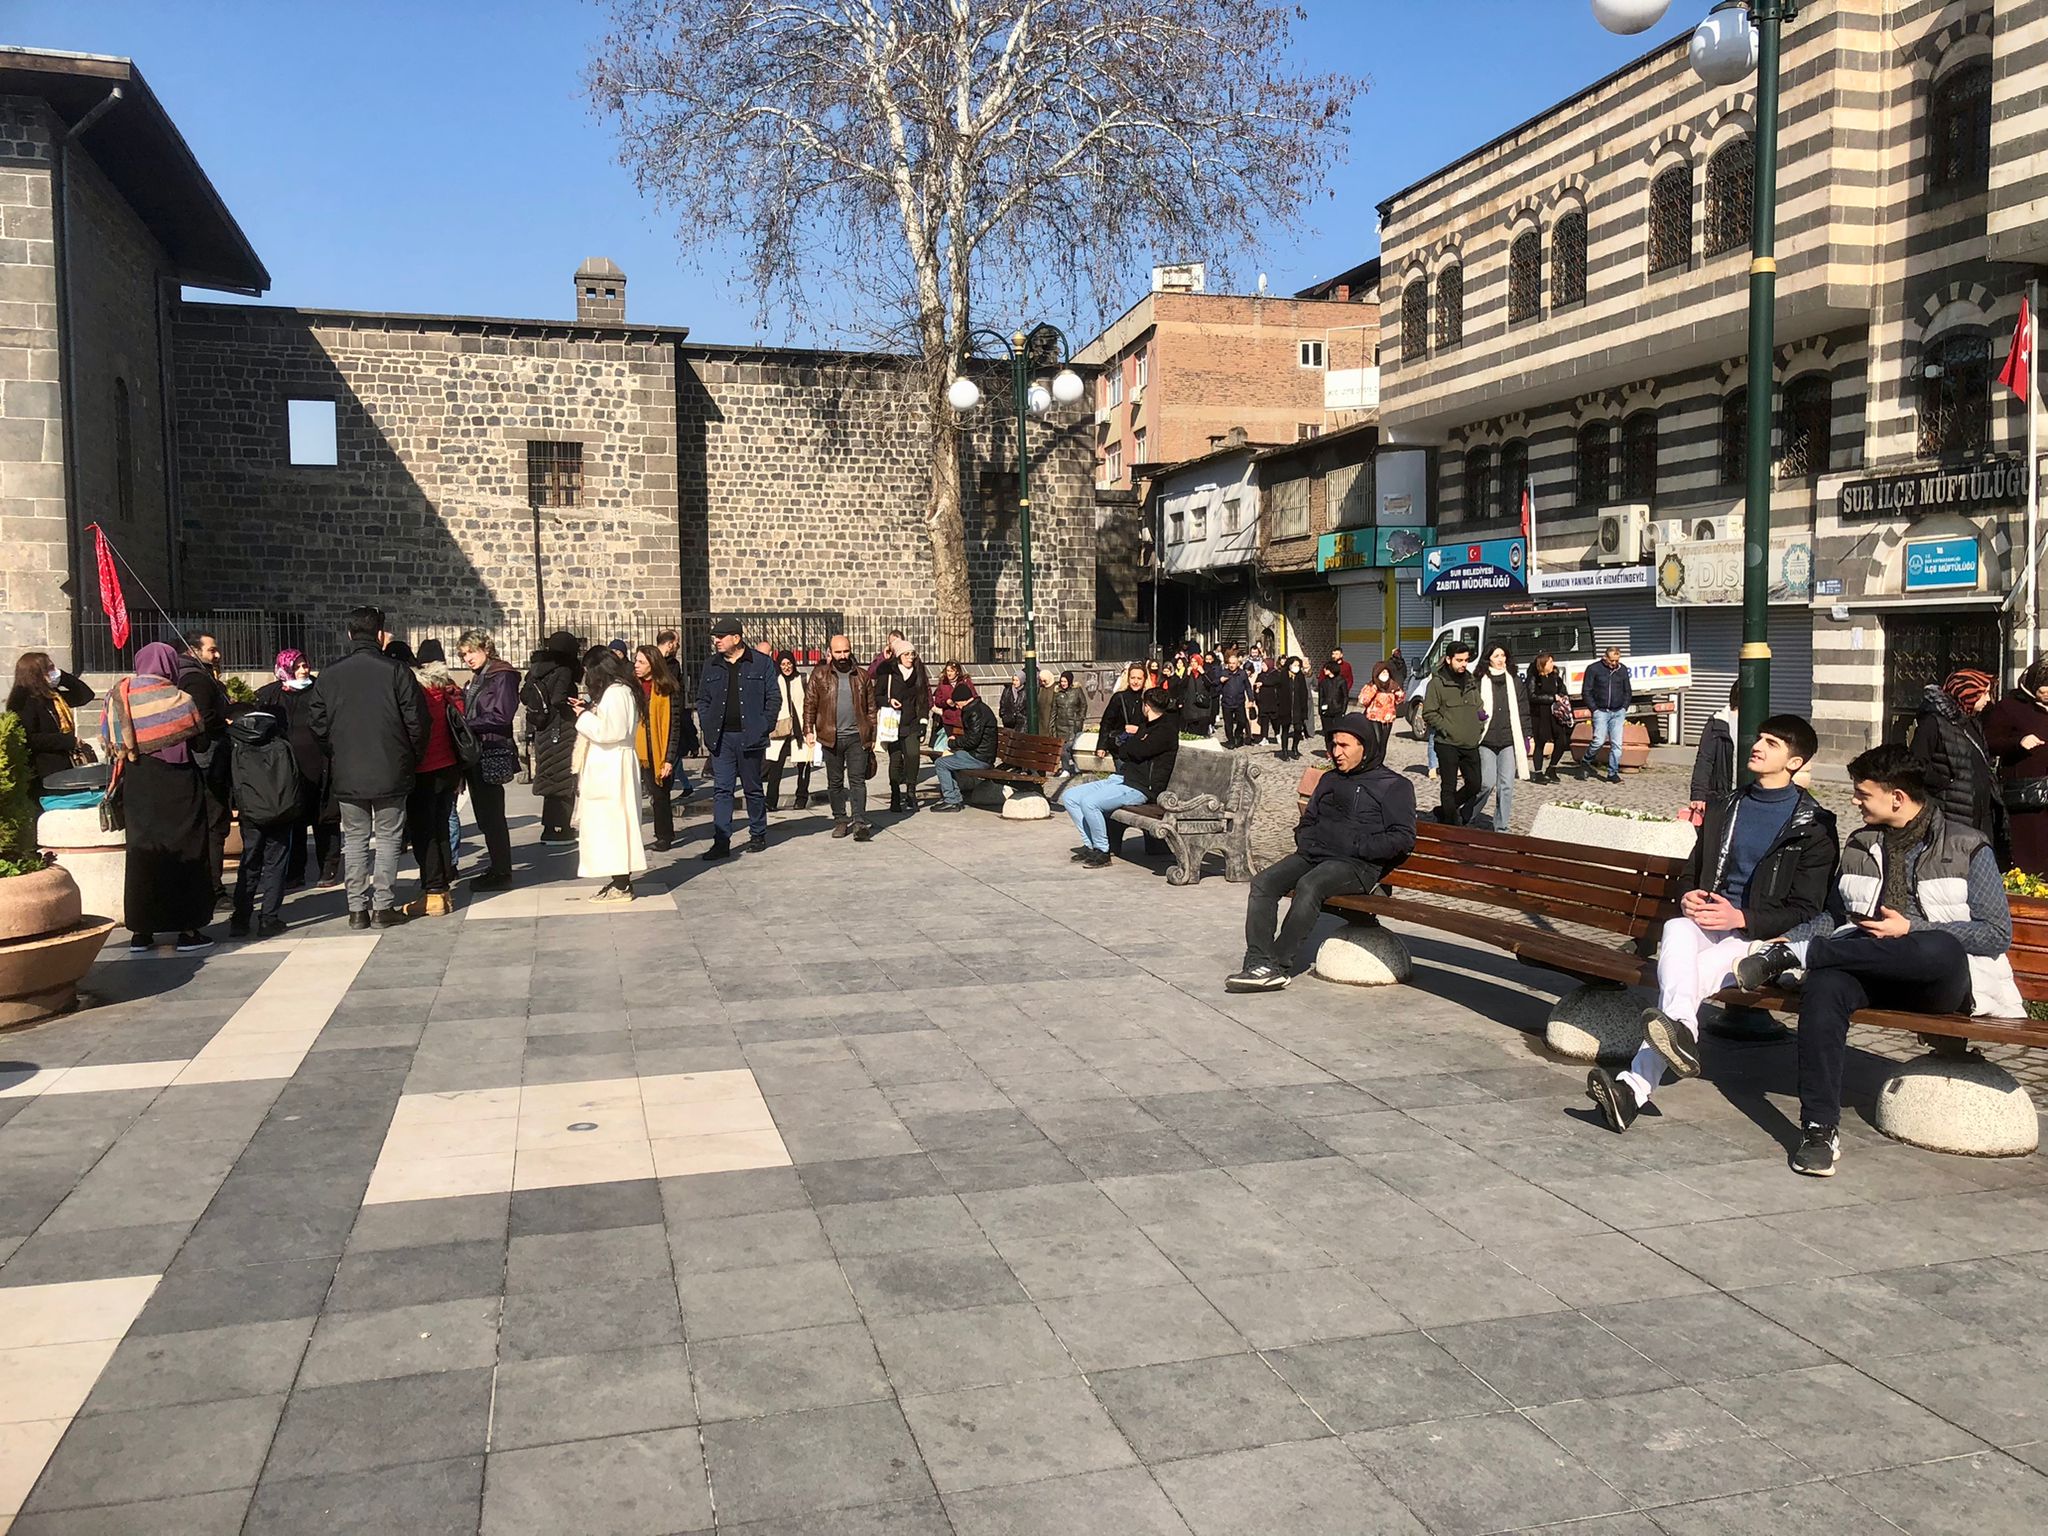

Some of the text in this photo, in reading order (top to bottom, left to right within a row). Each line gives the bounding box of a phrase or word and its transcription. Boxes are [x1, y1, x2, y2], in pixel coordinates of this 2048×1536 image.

[1843, 461, 2030, 516] SUR İLÇE MÜFTÜLÜĞÜ
[1450, 565, 1494, 577] SUR BELEDİYESİ
[1698, 560, 1744, 588] DİS
[1436, 575, 1510, 591] ZABITA MÜDÜRLÜĞÜ
[1542, 579, 1570, 588] HALKIMIZIN
[1571, 577, 1594, 587] YANINDA
[1595, 576, 1602, 585] VE
